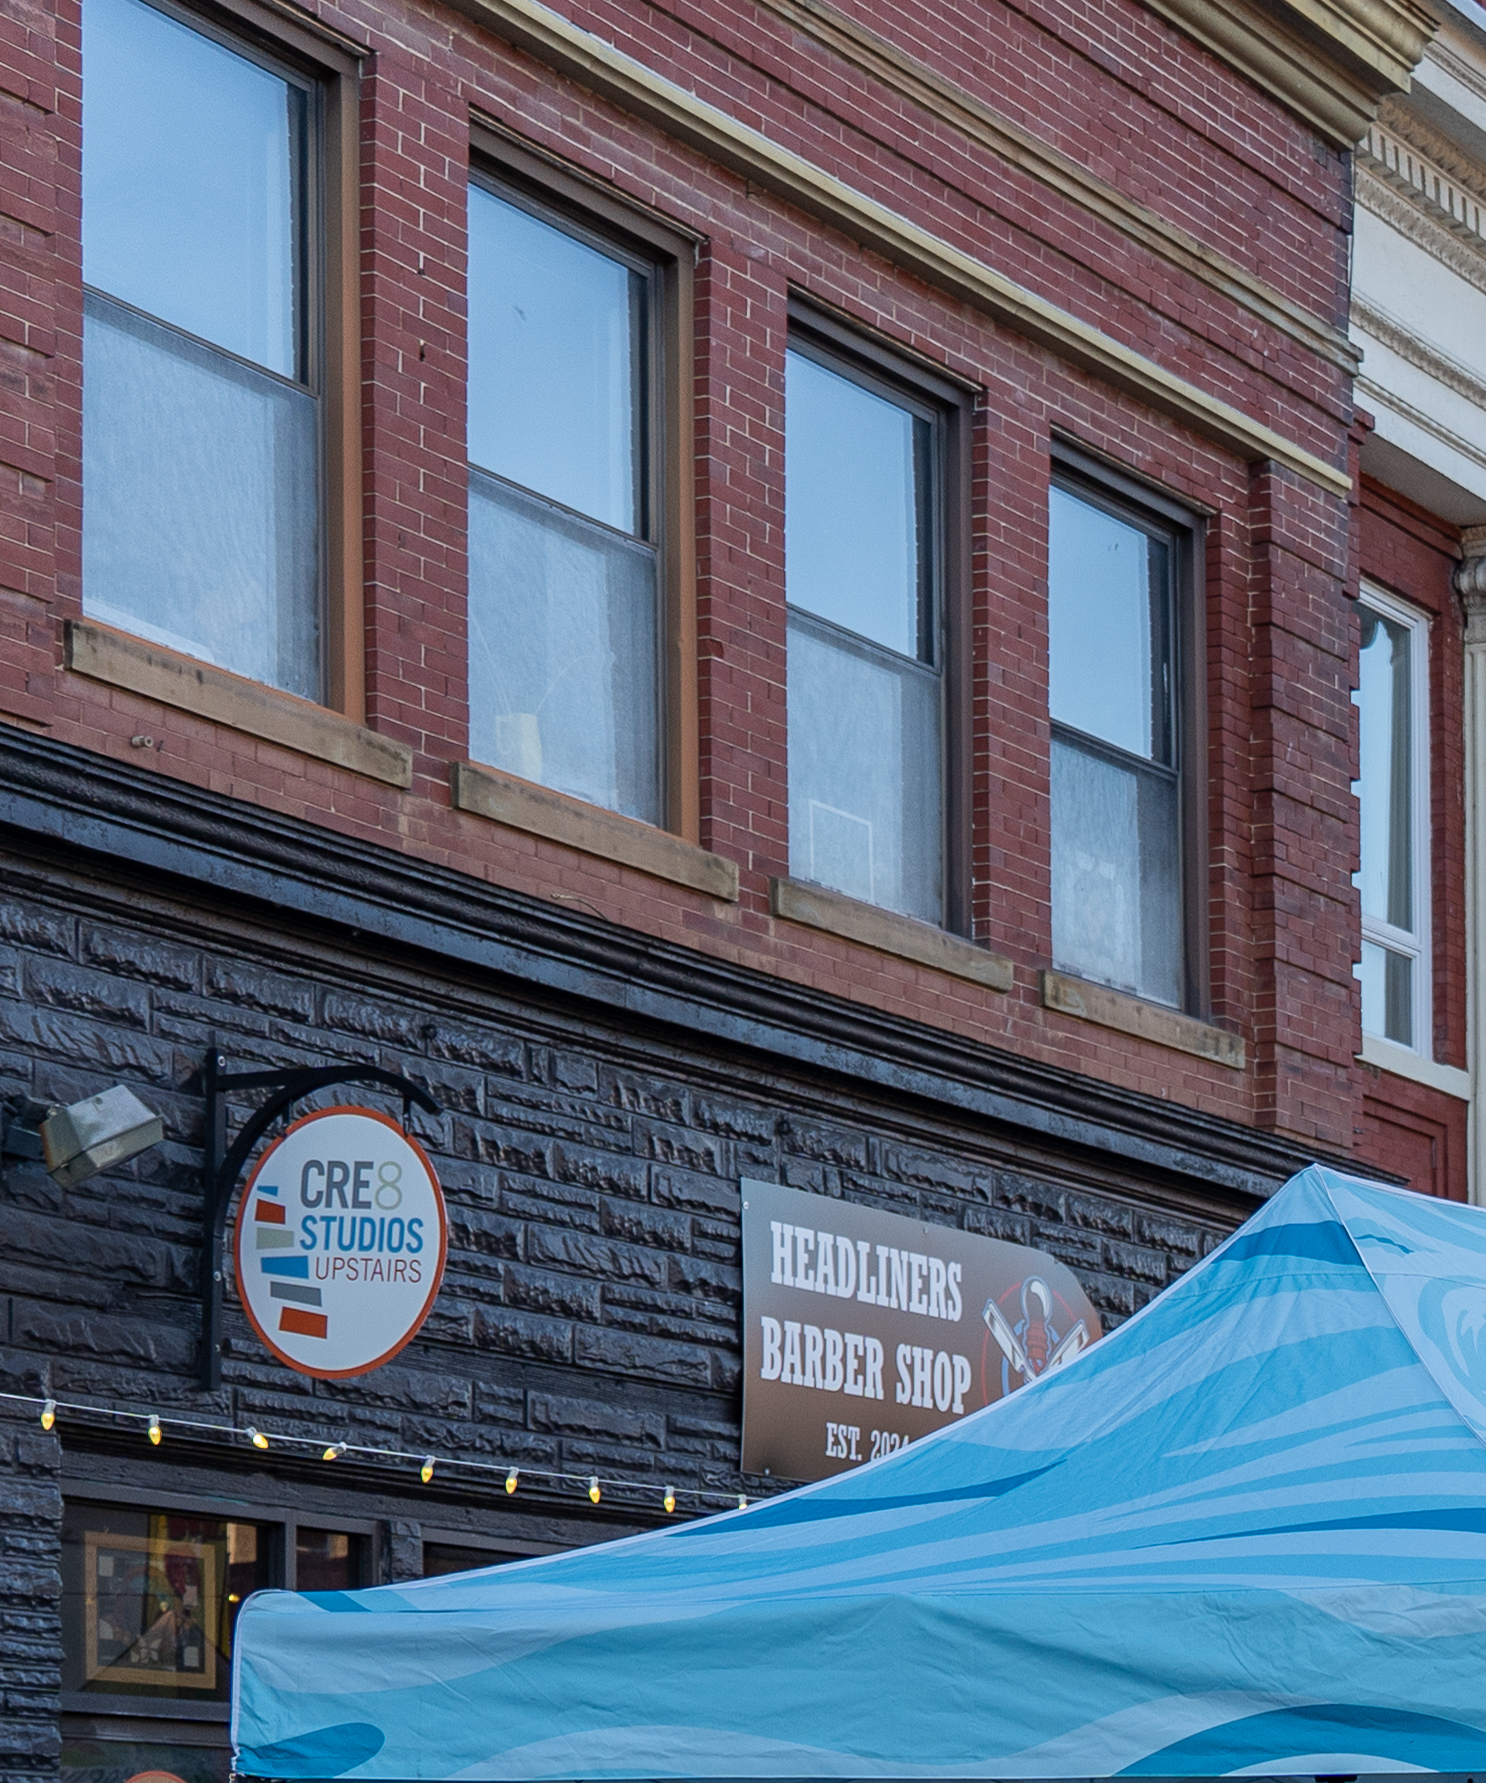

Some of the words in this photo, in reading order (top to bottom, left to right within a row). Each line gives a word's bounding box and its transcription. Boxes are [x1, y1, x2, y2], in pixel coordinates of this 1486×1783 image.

[300, 1159, 402, 1210] CRE8
[299, 1215, 424, 1254] STUDIOS
[315, 1257, 422, 1283] UPSTAIRS
[770, 1220, 962, 1322] HEADLINERS
[760, 1316, 885, 1401] BARBER
[895, 1343, 971, 1415] SHOP
[825, 1422, 862, 1461] EST.
